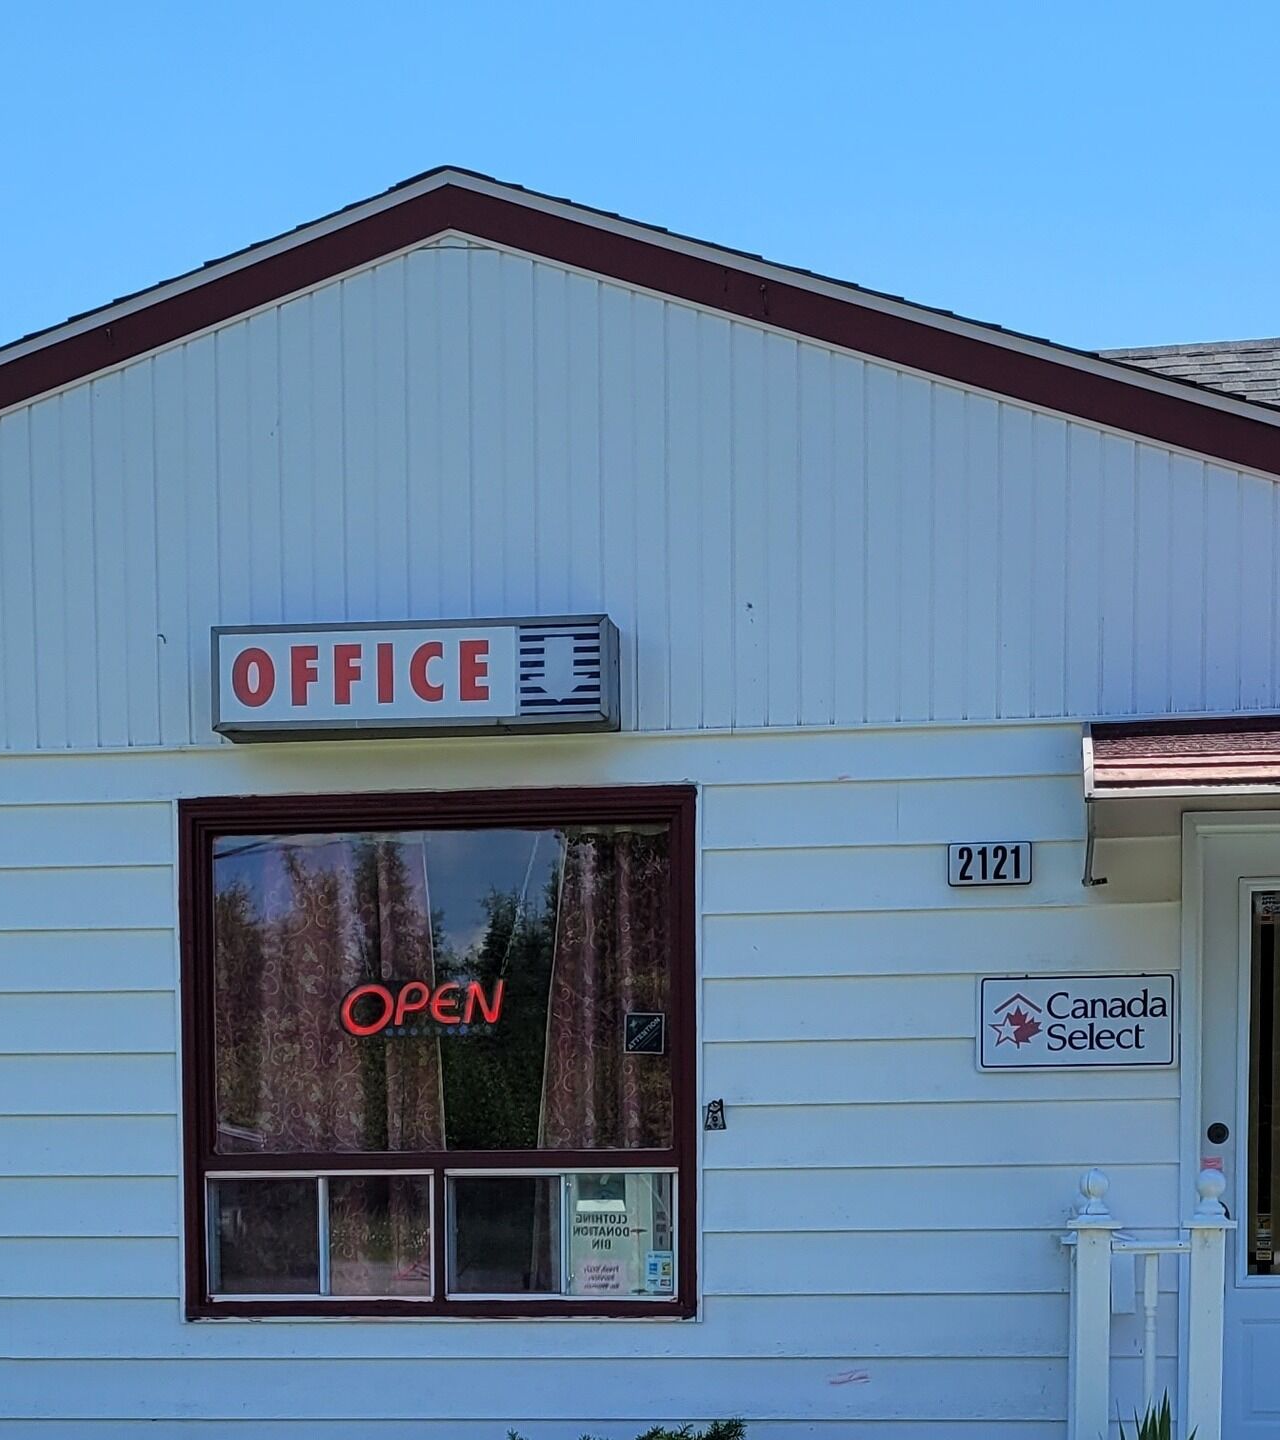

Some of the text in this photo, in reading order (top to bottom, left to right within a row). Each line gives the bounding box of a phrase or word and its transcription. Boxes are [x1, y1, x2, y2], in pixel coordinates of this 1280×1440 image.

[231, 639, 490, 708] OFFICE
[958, 845, 1022, 881] 2121
[340, 978, 506, 1037] OPEN
[1046, 988, 1168, 1021] Canada
[627, 1016, 661, 1050] ATTENTION
[1047, 1022, 1146, 1052] Select
